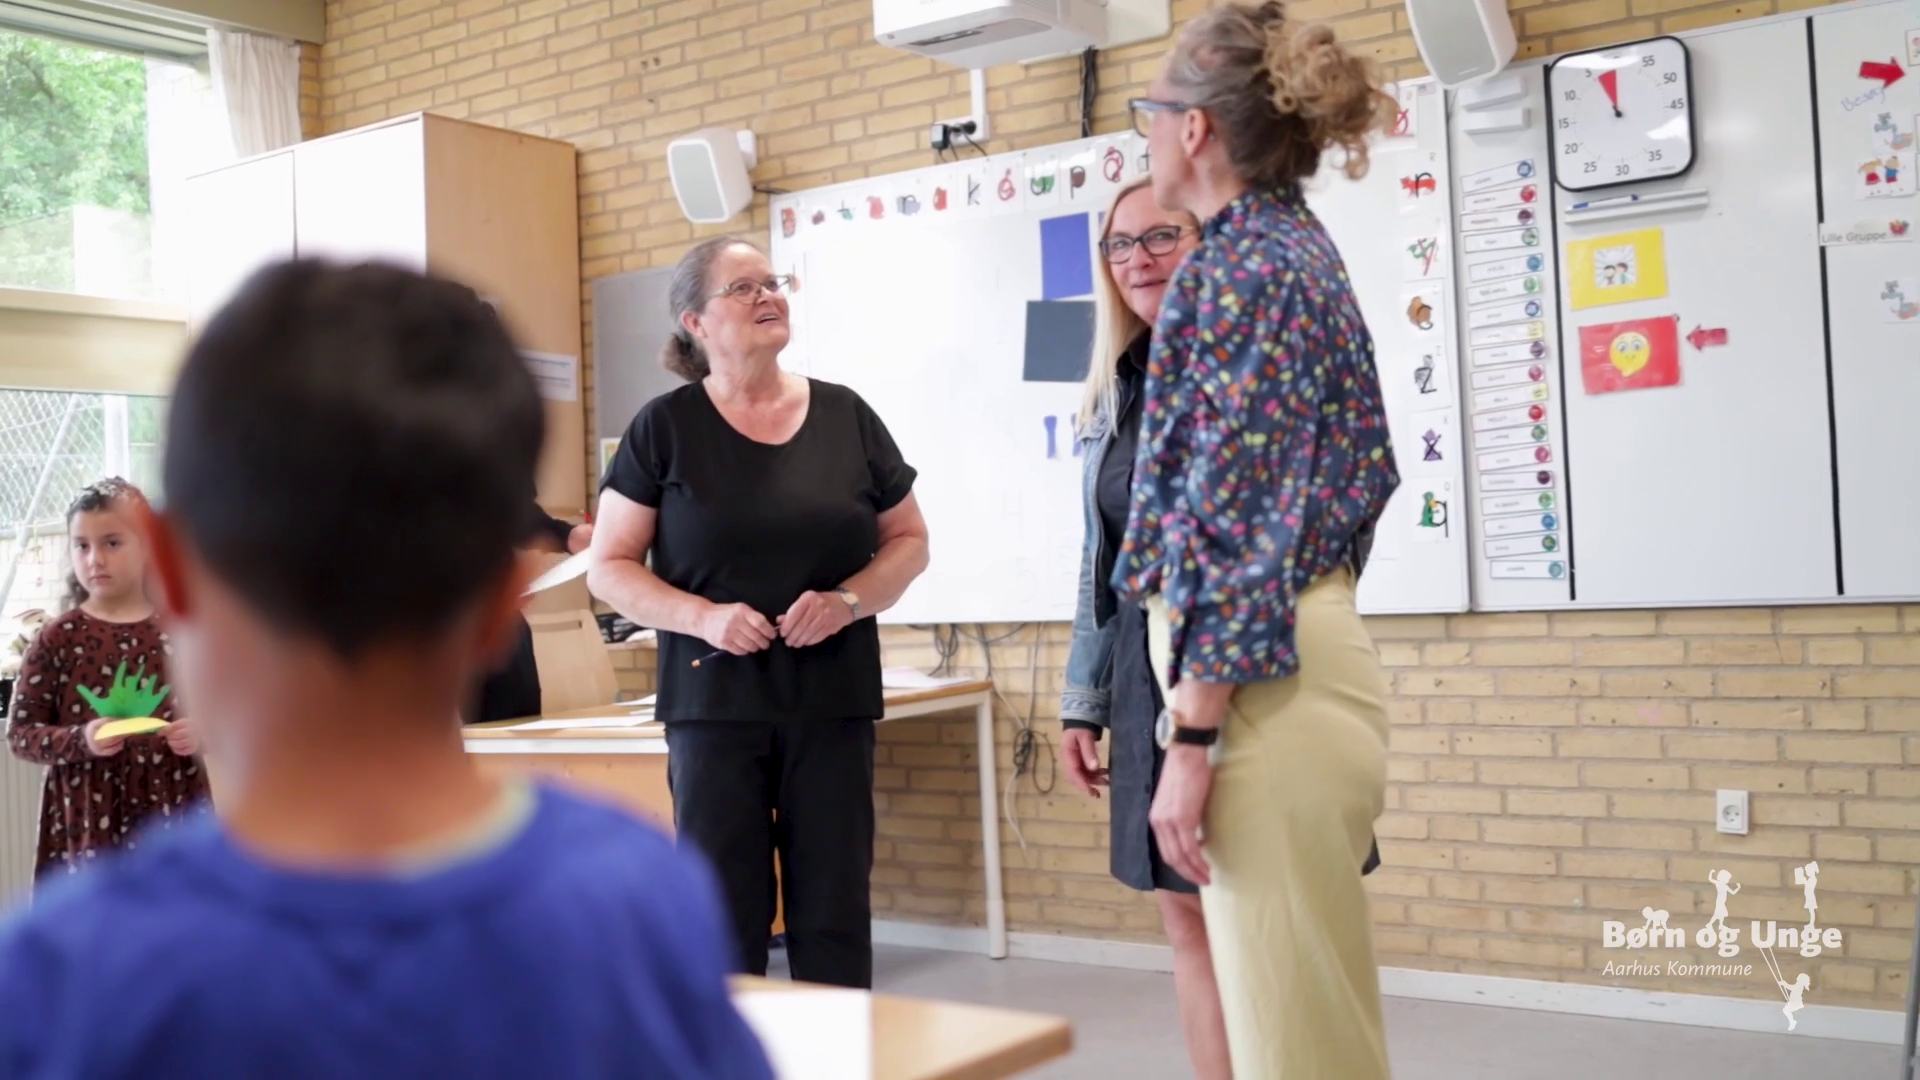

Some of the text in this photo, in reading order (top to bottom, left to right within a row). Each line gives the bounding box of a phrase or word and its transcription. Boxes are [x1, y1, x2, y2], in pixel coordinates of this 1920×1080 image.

[1642, 54, 1655, 67] 55
[1585, 68, 1592, 78] 5
[1663, 72, 1677, 84] 50
[1564, 90, 1576, 101] 10
[1670, 98, 1684, 109] 45
[1558, 118, 1570, 129] 15
[1564, 143, 1578, 155] 20
[1649, 150, 1662, 162] 35
[1584, 161, 1597, 173] 25
[1615, 164, 1630, 176] 30
[1070, 165, 1086, 200] p
[1415, 172, 1433, 198] r
[967, 174, 981, 205] k
[1821, 231, 1887, 244] Lille Gruppe
[1421, 433, 1443, 461] x
